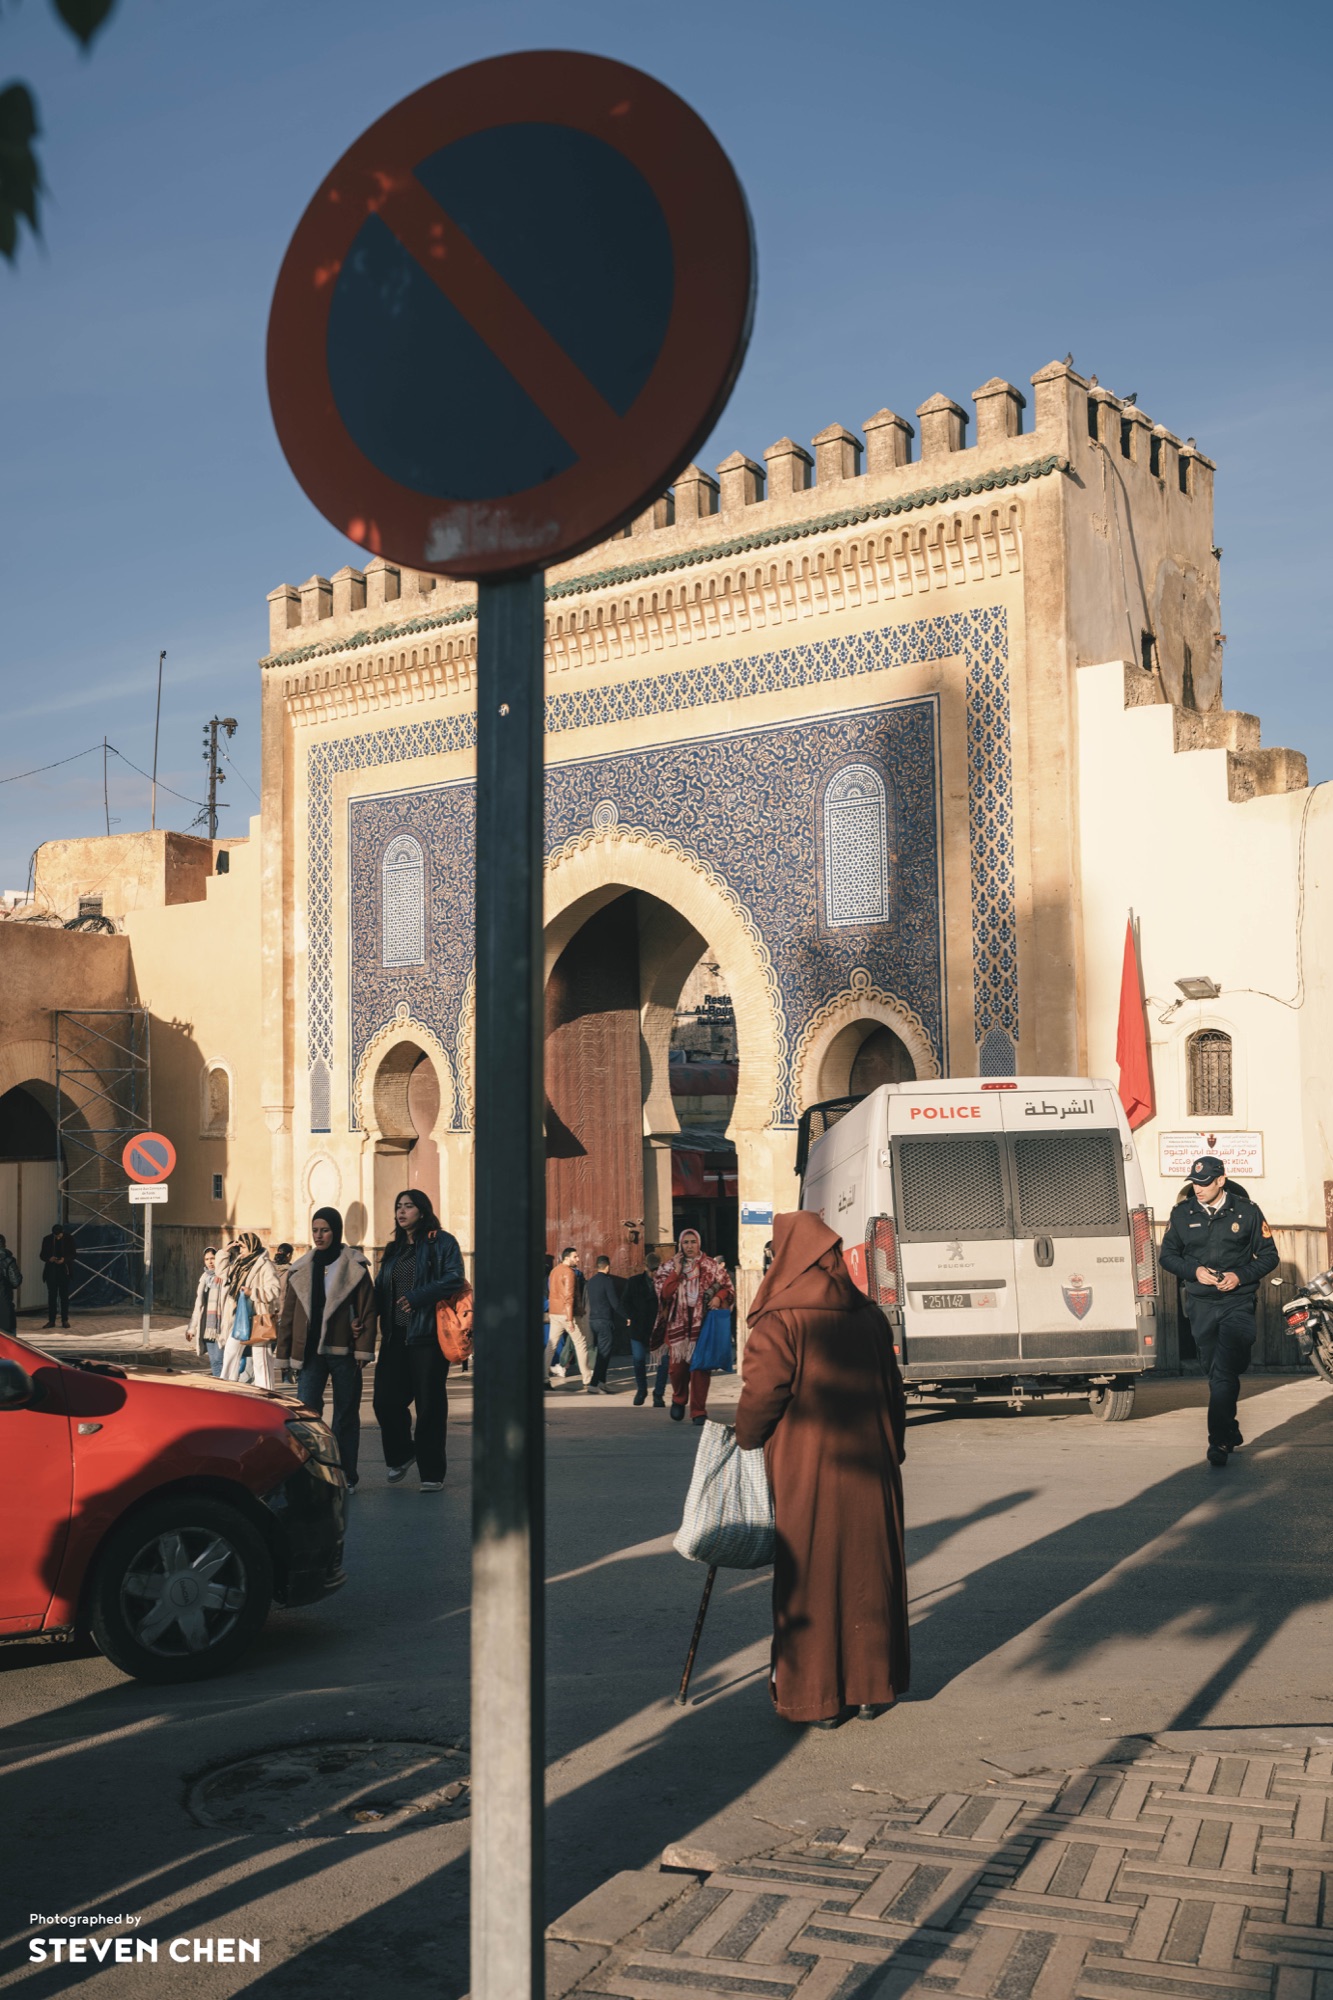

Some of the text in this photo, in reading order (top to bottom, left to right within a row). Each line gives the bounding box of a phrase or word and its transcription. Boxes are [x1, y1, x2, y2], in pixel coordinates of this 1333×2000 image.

[910, 1106, 981, 1120] POLICE
[1024, 1099, 1095, 1120] الشرطة
[1206, 1148, 1235, 1157] الشرطة
[1096, 1256, 1125, 1264] BOXER
[928, 1295, 965, 1308] 251142
